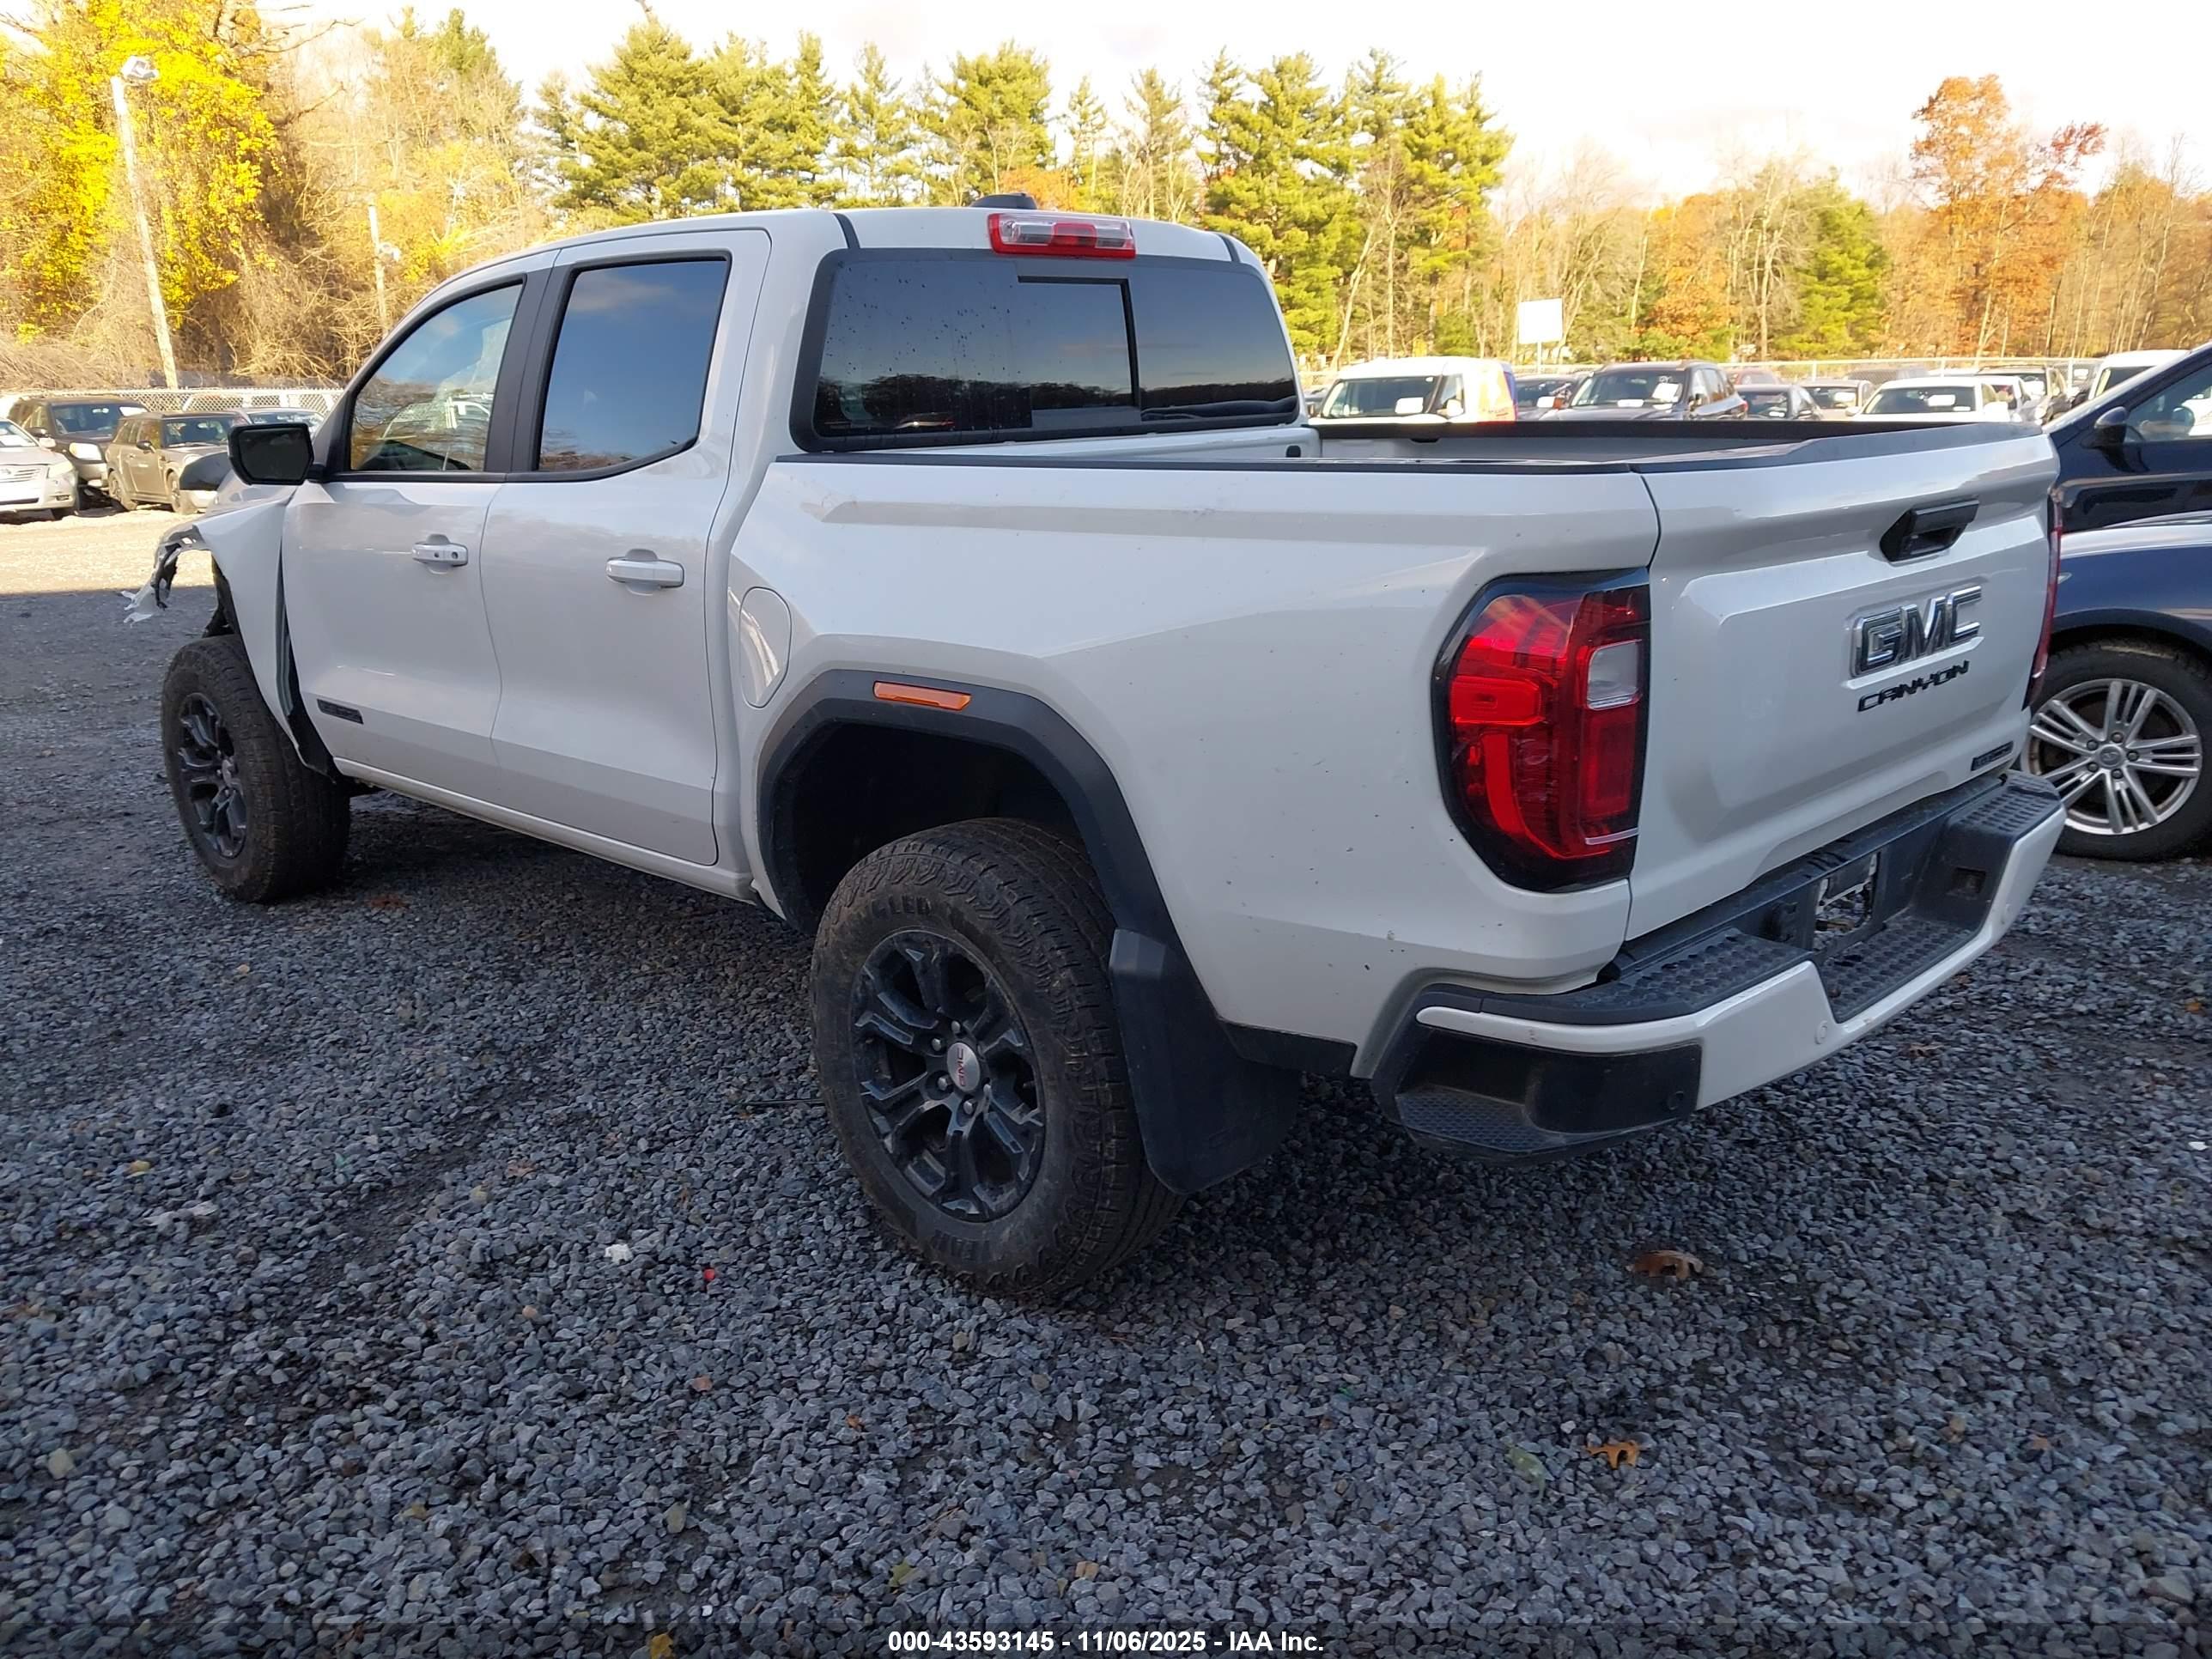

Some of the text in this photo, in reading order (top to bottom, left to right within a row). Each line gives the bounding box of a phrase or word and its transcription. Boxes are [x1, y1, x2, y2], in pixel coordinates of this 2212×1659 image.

[1850, 585, 1982, 678] GMC
[1856, 659, 1970, 712] CANYON
[956, 1047, 967, 1087] GMC
